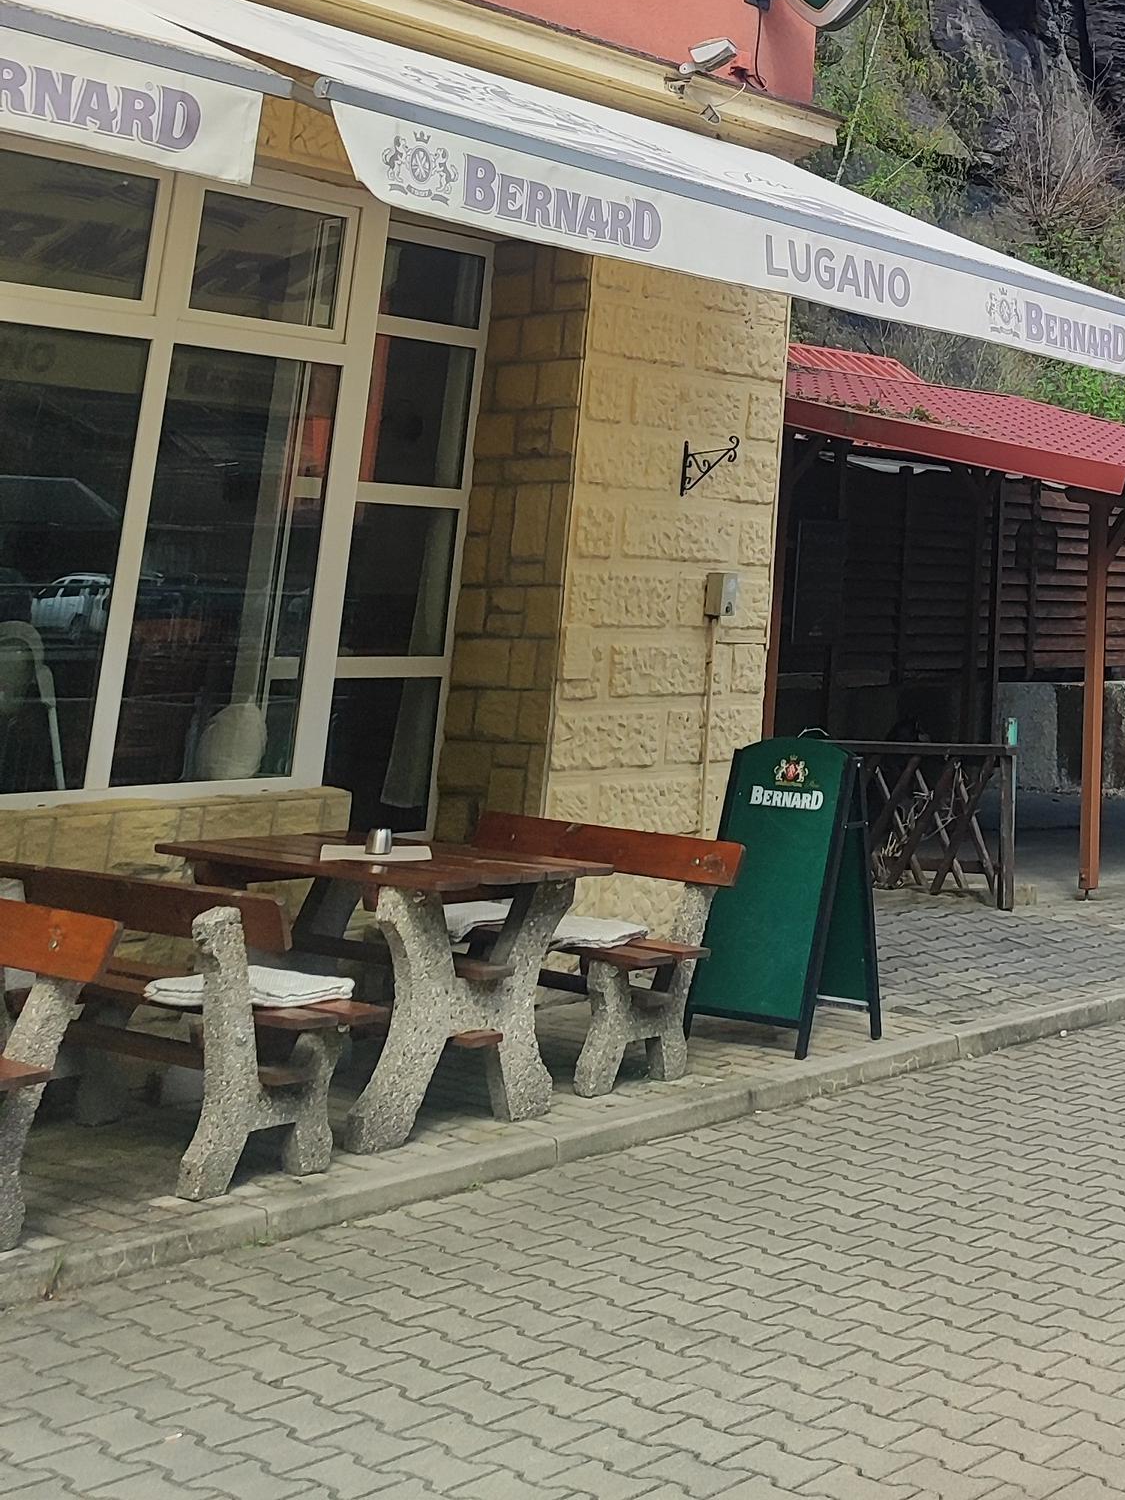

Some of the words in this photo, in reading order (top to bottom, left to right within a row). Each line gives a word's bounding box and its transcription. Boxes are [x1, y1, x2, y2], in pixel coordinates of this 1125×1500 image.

[461, 152, 662, 252] BERNARD
[765, 234, 912, 308] LUGANO
[749, 785, 824, 811] BERNARD
